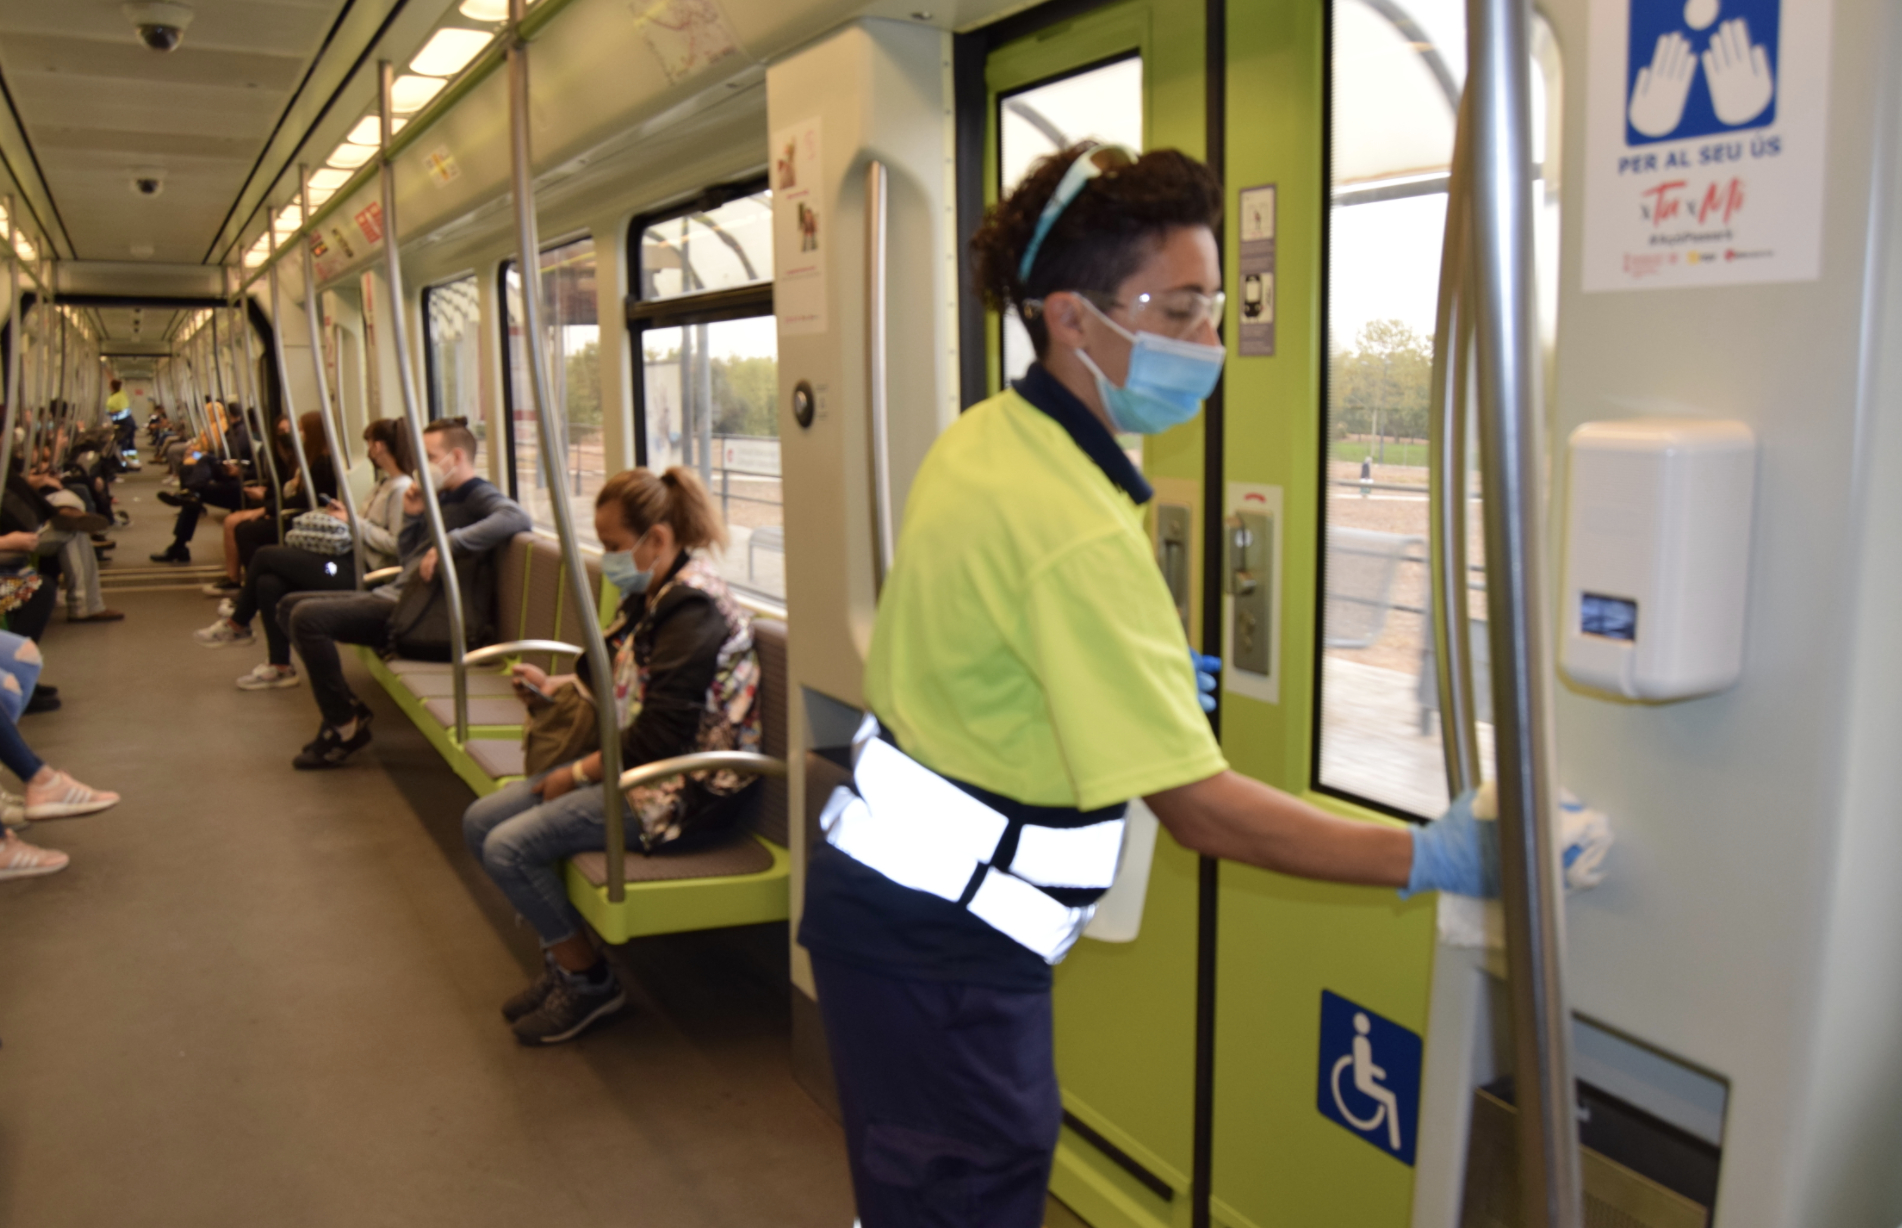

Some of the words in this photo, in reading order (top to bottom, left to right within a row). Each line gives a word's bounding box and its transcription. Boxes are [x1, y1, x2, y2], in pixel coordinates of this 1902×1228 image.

[1618, 154, 1657, 175] PER
[1665, 151, 1691, 169] AL
[1698, 142, 1742, 164] SEU
[1750, 134, 1782, 158] ÚS
